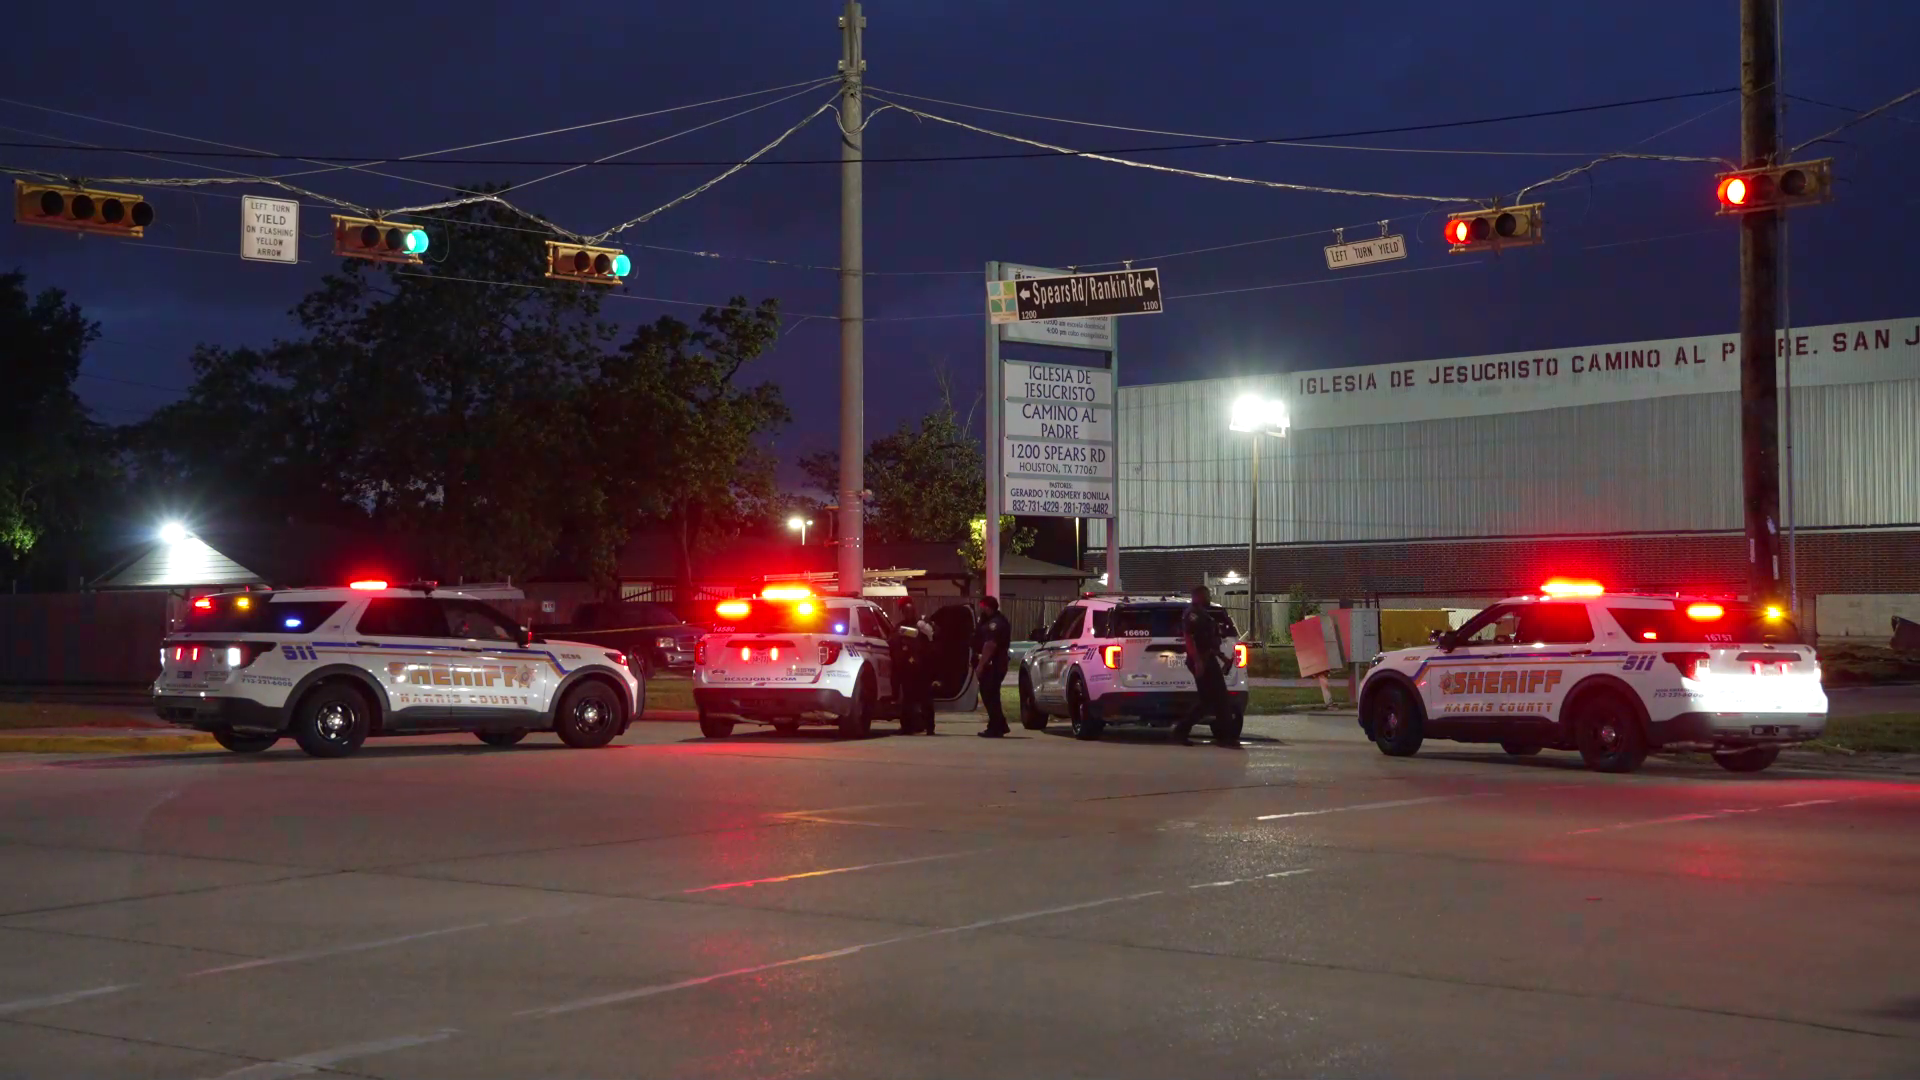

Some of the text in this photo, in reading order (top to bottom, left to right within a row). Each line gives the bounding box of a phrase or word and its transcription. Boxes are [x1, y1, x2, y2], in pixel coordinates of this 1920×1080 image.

[251, 201, 290, 213] LEFT TURN
[255, 213, 287, 226] YIELD
[246, 225, 294, 238] ON FLASHING
[256, 237, 284, 246] YELLOW
[257, 248, 282, 257] ARROW
[1330, 241, 1399, 262] LEFT TURN YIELD
[1032, 281, 1071, 310] Spears
[1128, 273, 1143, 297] Rd
[1143, 301, 1158, 310] 1100
[1021, 310, 1037, 320] 1200
[1300, 373, 1377, 395] IGLESIA
[1391, 370, 1415, 388] DE
[1429, 358, 1558, 384] JESUCRISTO
[1571, 349, 1661, 373] CAMINO
[1675, 345, 1705, 366] AL
[1832, 329, 1890, 352] SAN
[1029, 365, 1092, 384] IGLESIA DE
[1025, 383, 1096, 402] JESUCRISTO
[1022, 403, 1097, 423] CAMINO AL
[1041, 423, 1080, 439] PADRE
[1012, 443, 1106, 463] 1200 SPEARS RD
[1020, 462, 1098, 475] HOUSTON, TX 77067
[1011, 488, 1110, 501] GERARDO Y ROSMERY BONILLA
[1012, 500, 1109, 515] 832-731-4229 281-739-4482
[1704, 634, 1733, 642] 16757
[1622, 654, 1657, 671] 911
[388, 661, 522, 688] SHERIFF
[1454, 669, 1563, 694] SHERIFF
[400, 693, 528, 705] HARRIS COUNTY
[1443, 702, 1553, 713] HARRIS COUNTY
